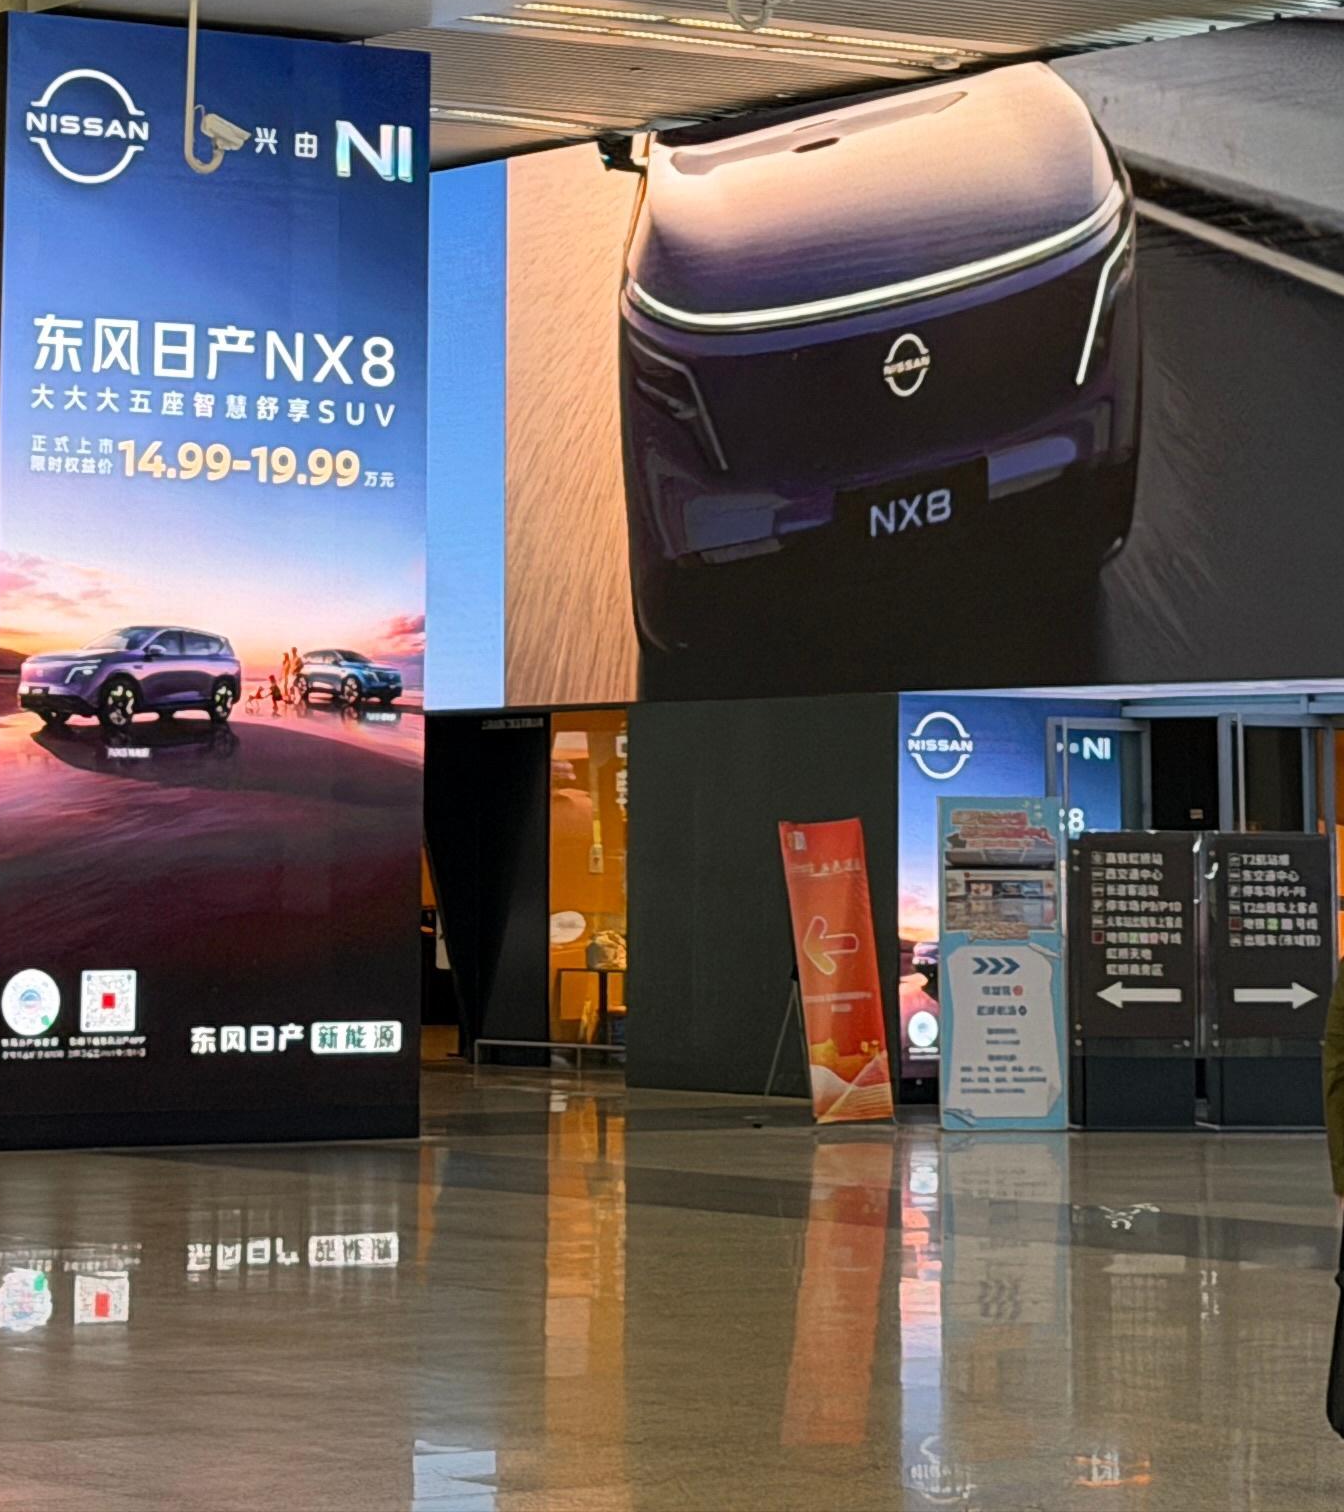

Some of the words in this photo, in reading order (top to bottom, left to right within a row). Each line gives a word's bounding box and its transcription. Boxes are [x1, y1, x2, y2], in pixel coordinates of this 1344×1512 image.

[25, 111, 150, 141] NISSAN
[254, 127, 318, 158] 兴由
[33, 313, 396, 388] 东风日产NX8
[883, 355, 931, 376] NISSAN
[30, 384, 396, 427] 大大大五座智慧舒享SUV
[31, 434, 114, 455] 正式上市
[30, 455, 114, 475] 限时权益价
[118, 440, 360, 487] 14.99-19.99
[363, 471, 395, 488] 万元
[870, 489, 952, 537] NX8
[908, 739, 973, 752] NISSAN
[191, 1022, 305, 1054] 东风日产
[317, 1024, 395, 1050] 新能源
